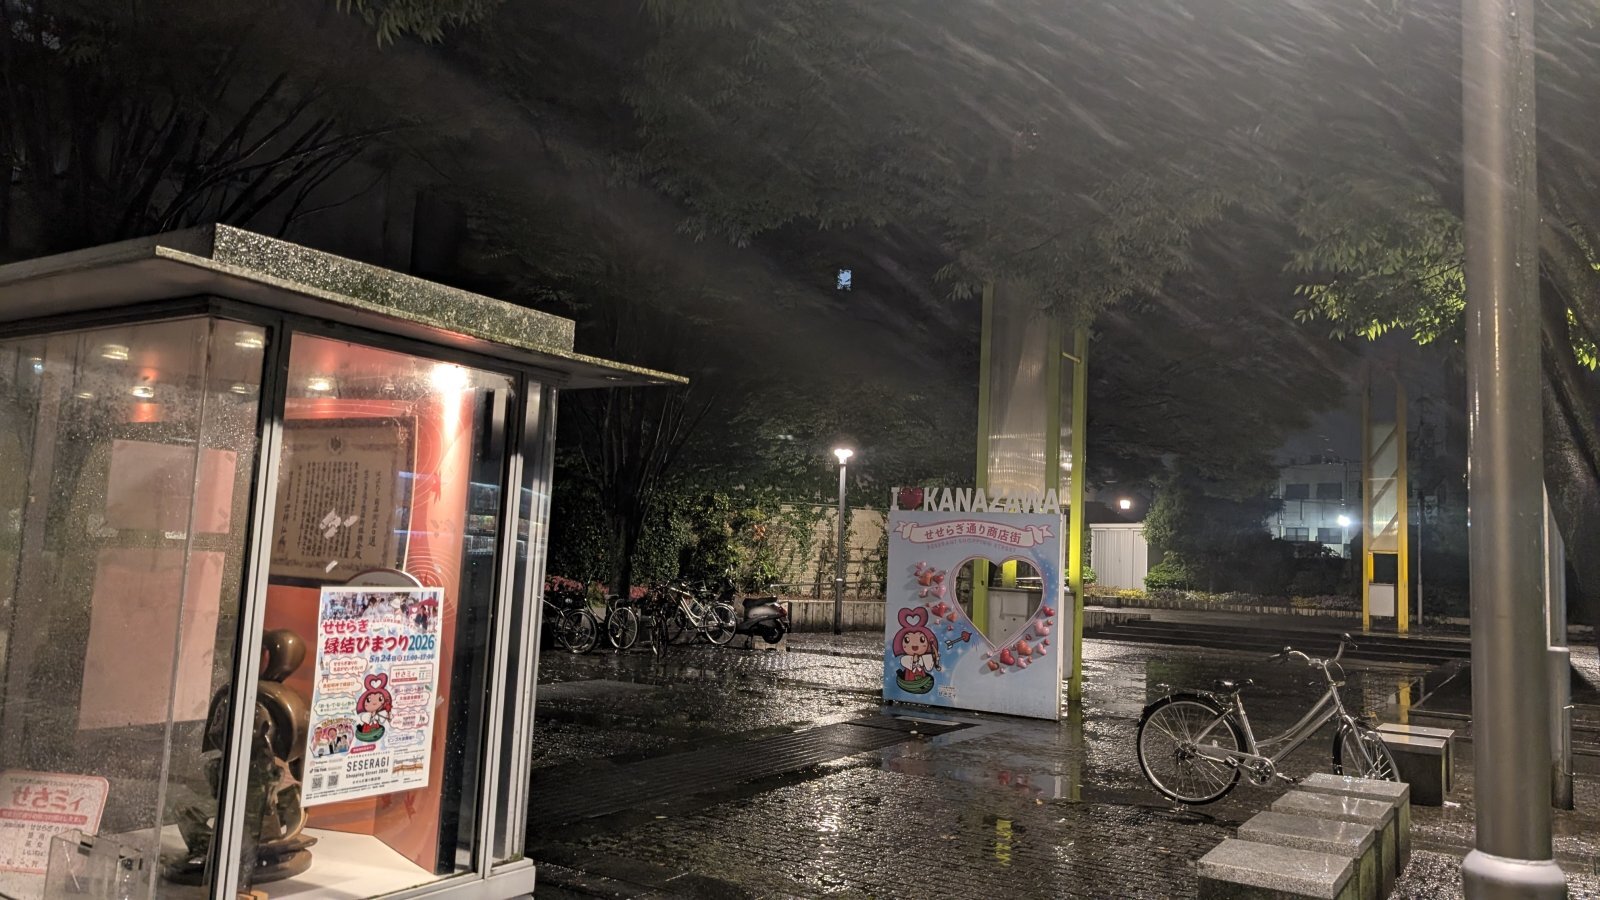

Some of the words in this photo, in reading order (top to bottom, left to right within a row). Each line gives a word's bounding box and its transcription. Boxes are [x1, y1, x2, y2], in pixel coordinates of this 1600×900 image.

[891, 487, 900, 511] I
[923, 487, 1060, 513] KANAZAWA
[925, 522, 1021, 544] せせらぎ通り商店街
[322, 618, 369, 635] せせらぎ
[346, 756, 390, 773] SESERAGI
[12, 785, 85, 812] せさミィ
